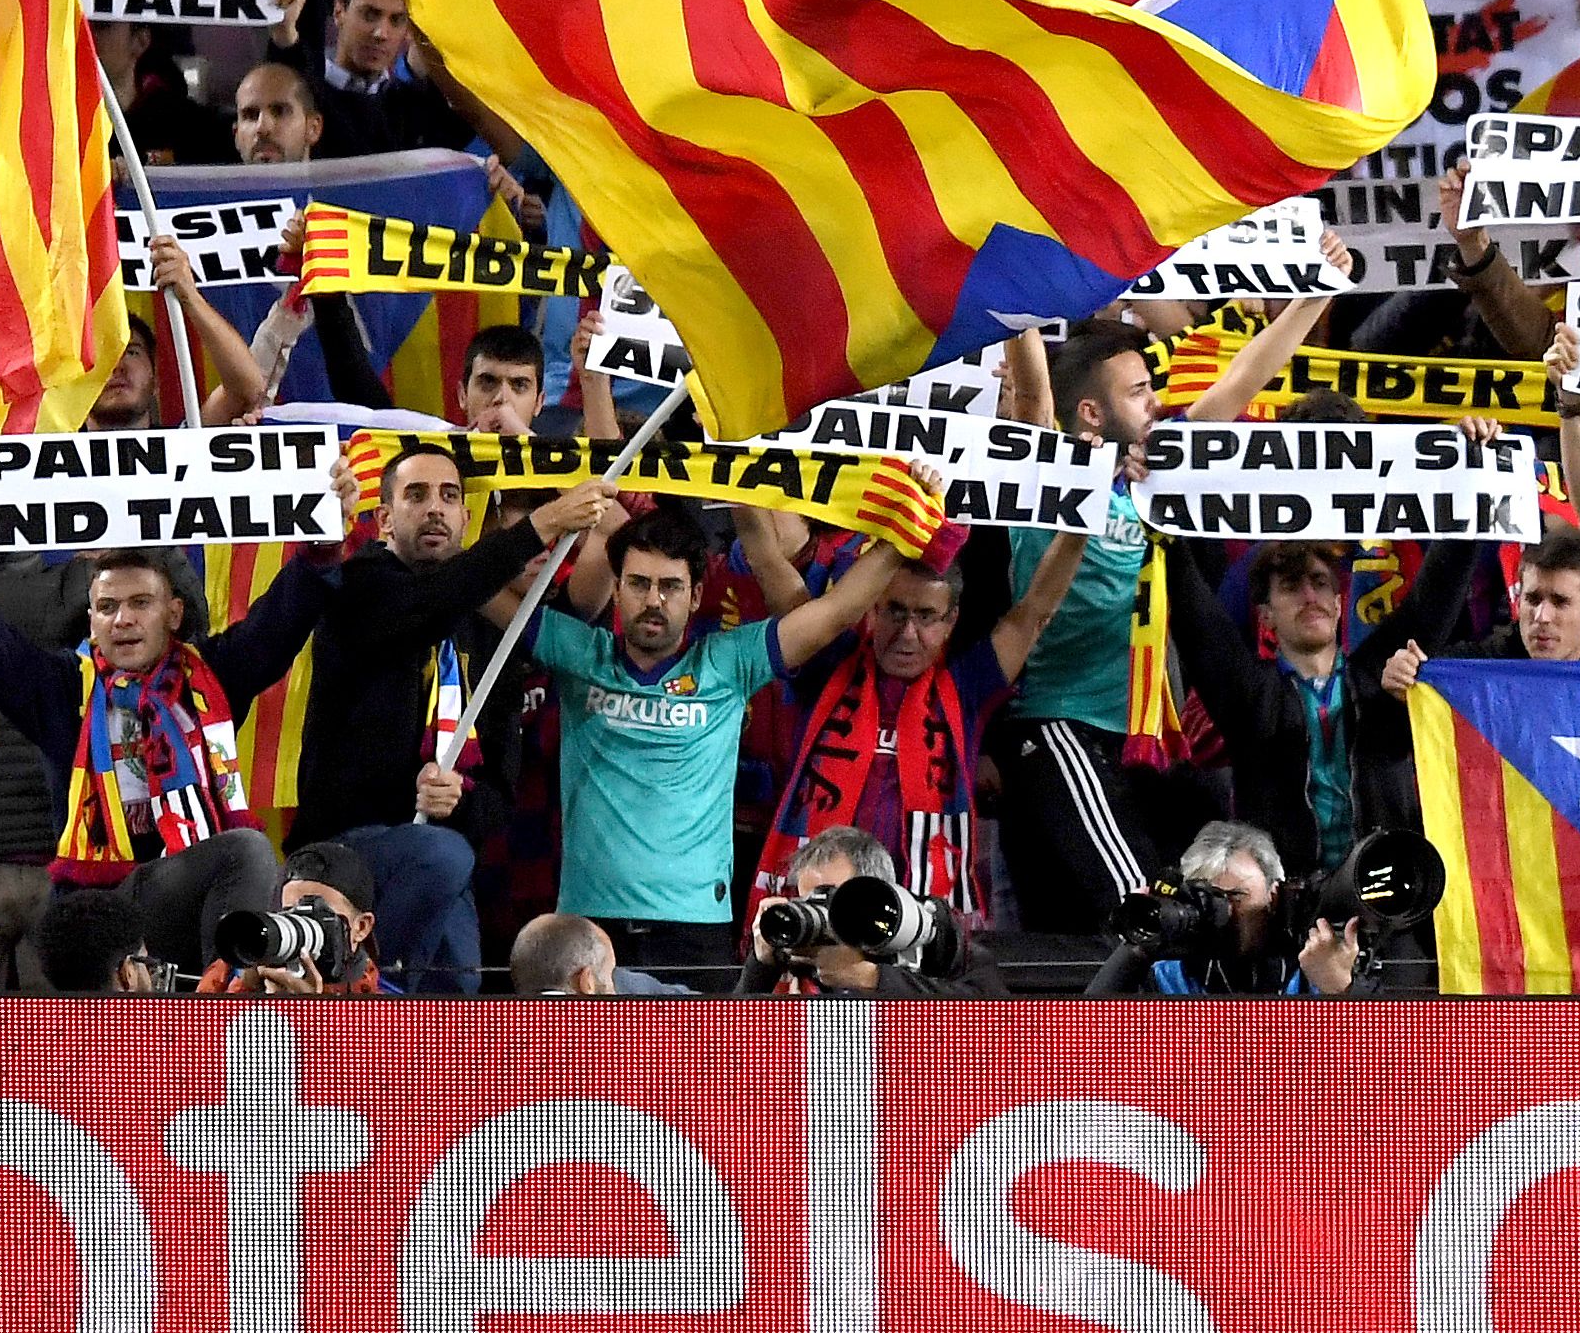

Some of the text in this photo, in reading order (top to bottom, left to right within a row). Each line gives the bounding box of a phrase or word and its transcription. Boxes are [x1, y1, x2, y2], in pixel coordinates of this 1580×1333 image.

[171, 203, 283, 240] SIT
[367, 217, 610, 298] LLIBER
[1172, 263, 1342, 295] TALK
[208, 431, 327, 473] SIT
[1146, 429, 1394, 479] SPAIN,
[127, 493, 327, 541] TALK
[946, 478, 1095, 529] ALK
[1148, 493, 1313, 535] AND
[1331, 492, 1525, 536] TALK
[586, 684, 708, 729] Rakuten
